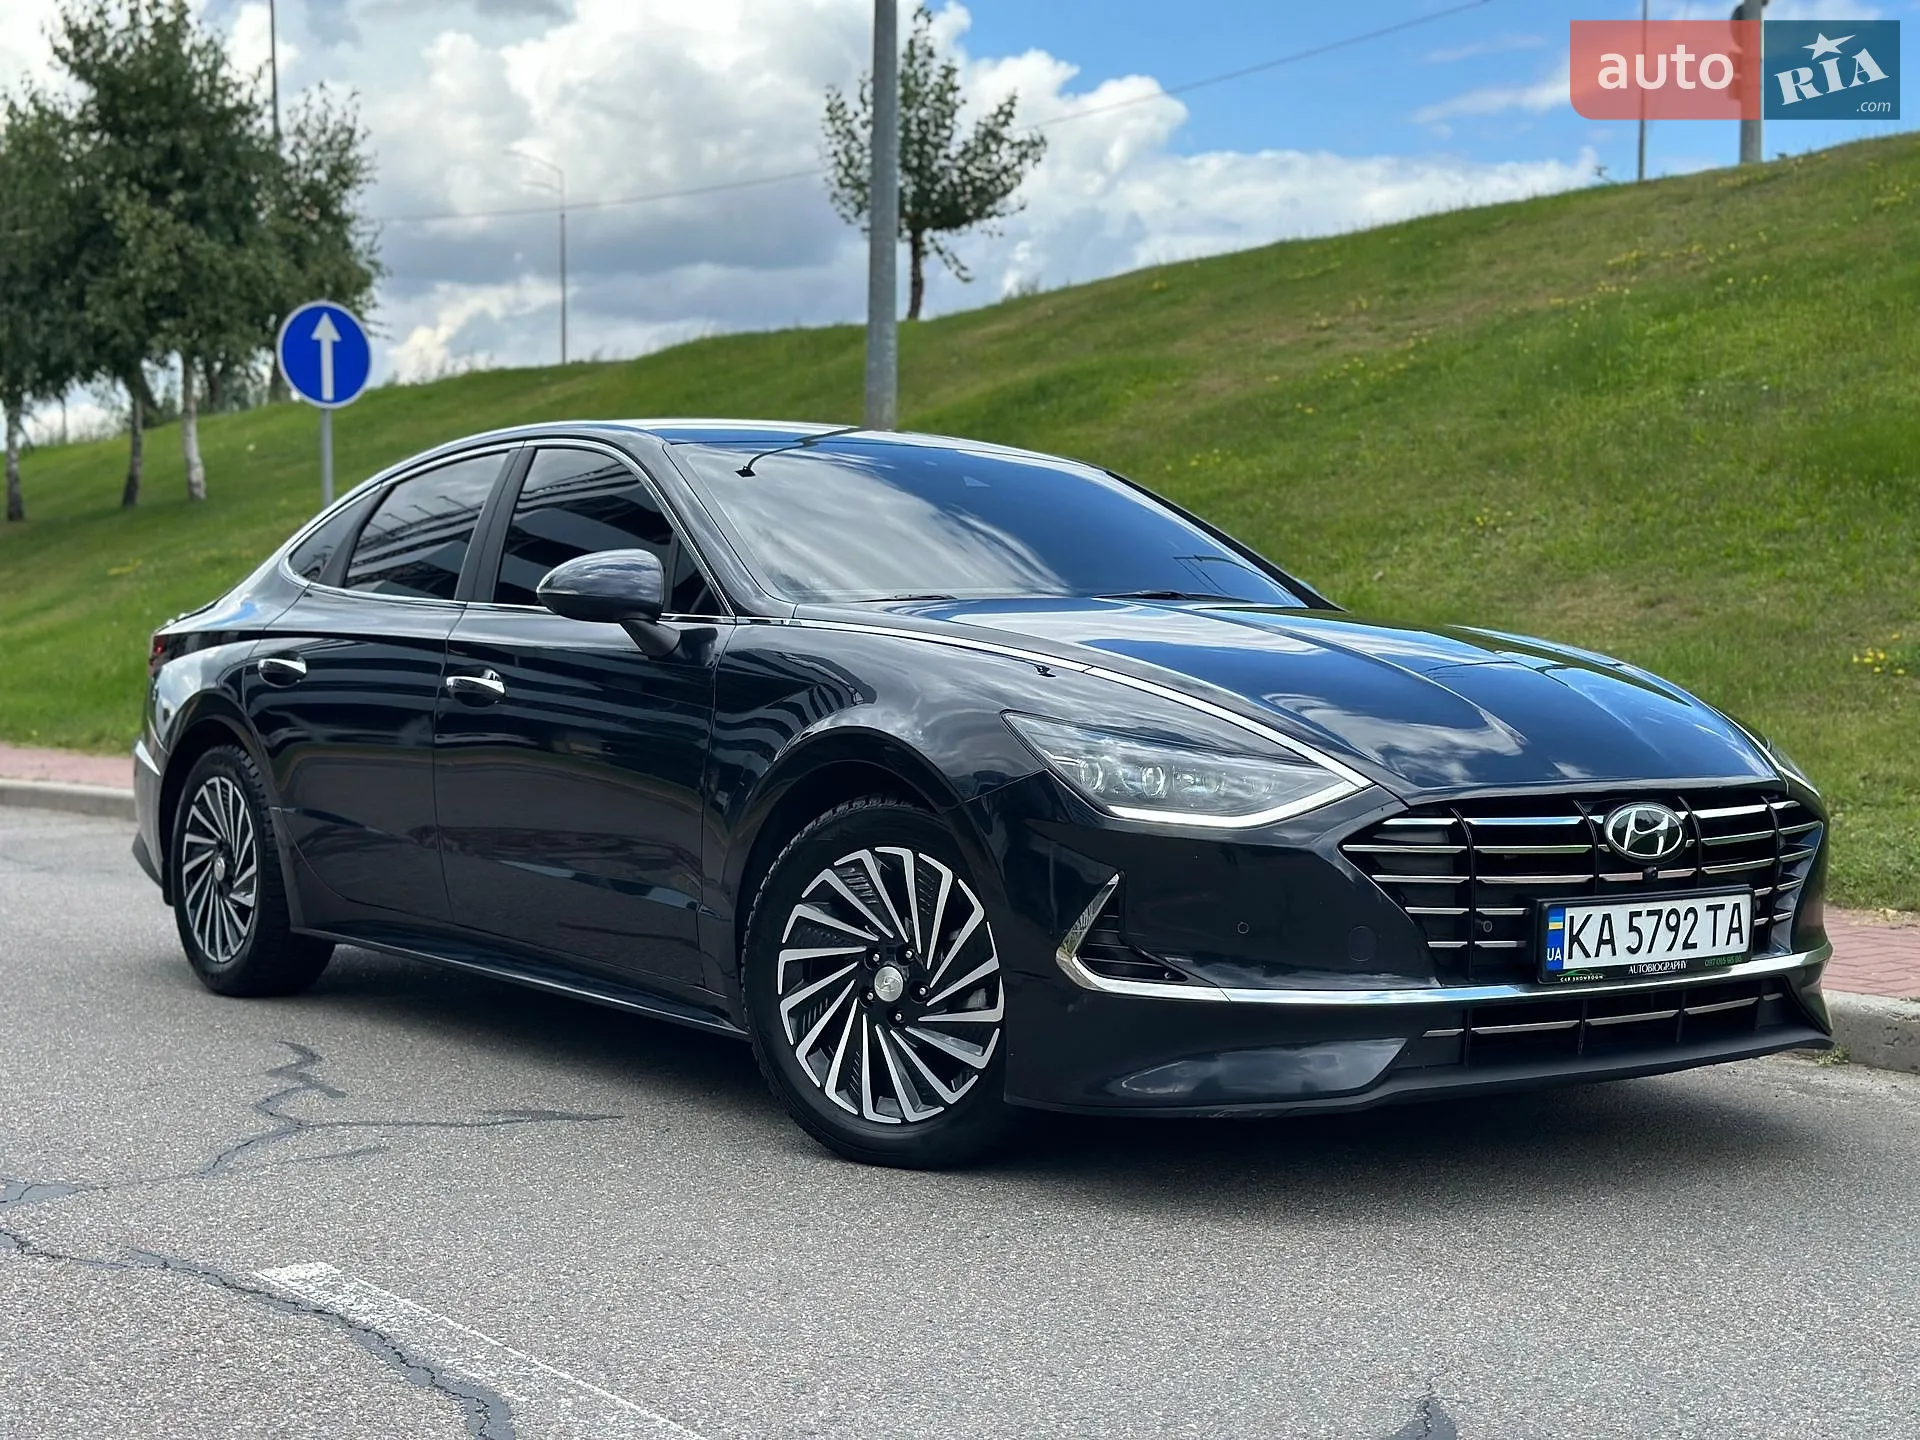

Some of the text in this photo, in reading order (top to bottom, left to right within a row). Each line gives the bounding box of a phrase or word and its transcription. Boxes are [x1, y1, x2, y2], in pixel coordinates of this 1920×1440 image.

[1567, 902, 1744, 960] KA 5792 TA
[1547, 948, 1562, 961] UA
[1628, 960, 1688, 974] AUTOBIOGRAPHY
